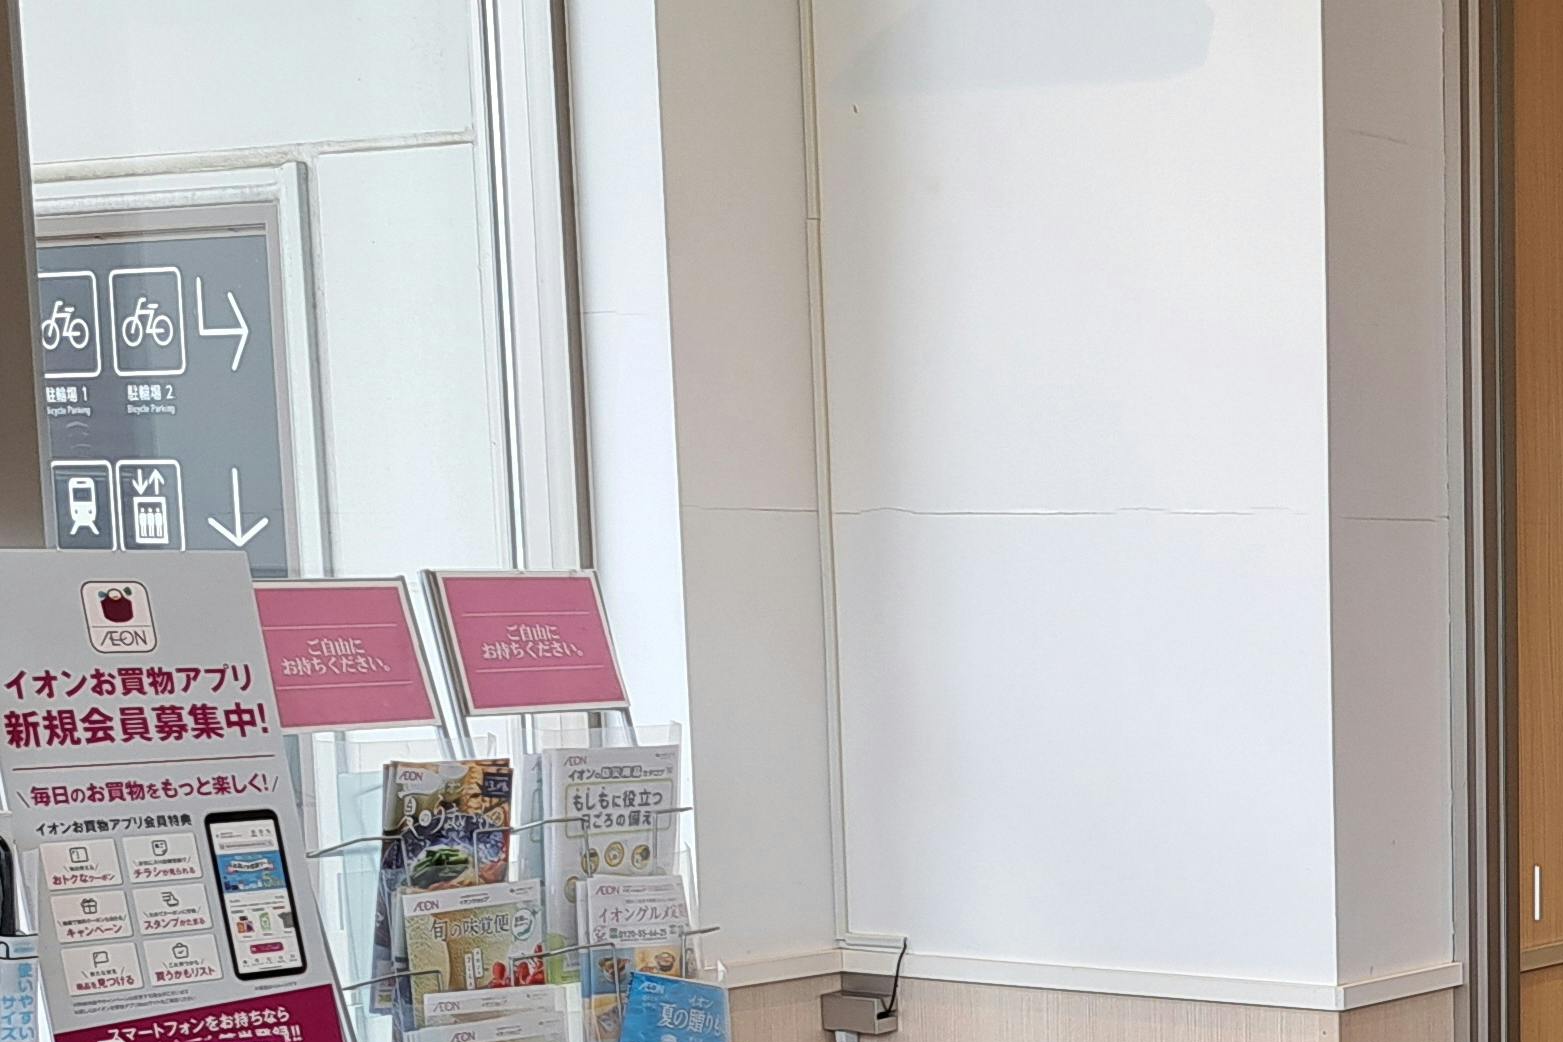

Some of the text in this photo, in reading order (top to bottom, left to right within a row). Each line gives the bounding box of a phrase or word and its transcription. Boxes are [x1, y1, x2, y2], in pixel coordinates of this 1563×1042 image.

[82, 385, 88, 401] 1
[165, 384, 175, 400] 2
[506, 624, 561, 642] ご自由に
[306, 638, 366, 656] ご自由に
[481, 640, 584, 661] お持ちください。
[280, 655, 392, 677] お持ちください。
[4, 663, 252, 700] イオンお買物アプリ
[4, 702, 270, 749] 新規会員募集中!
[30, 772, 269, 807] 毎日のお買物をもっと楽しく!
[573, 787, 664, 812] もしもに役立つ
[430, 913, 510, 943] 旬の味覚便
[108, 1007, 290, 1041] スマートフォンをお持ちなら
